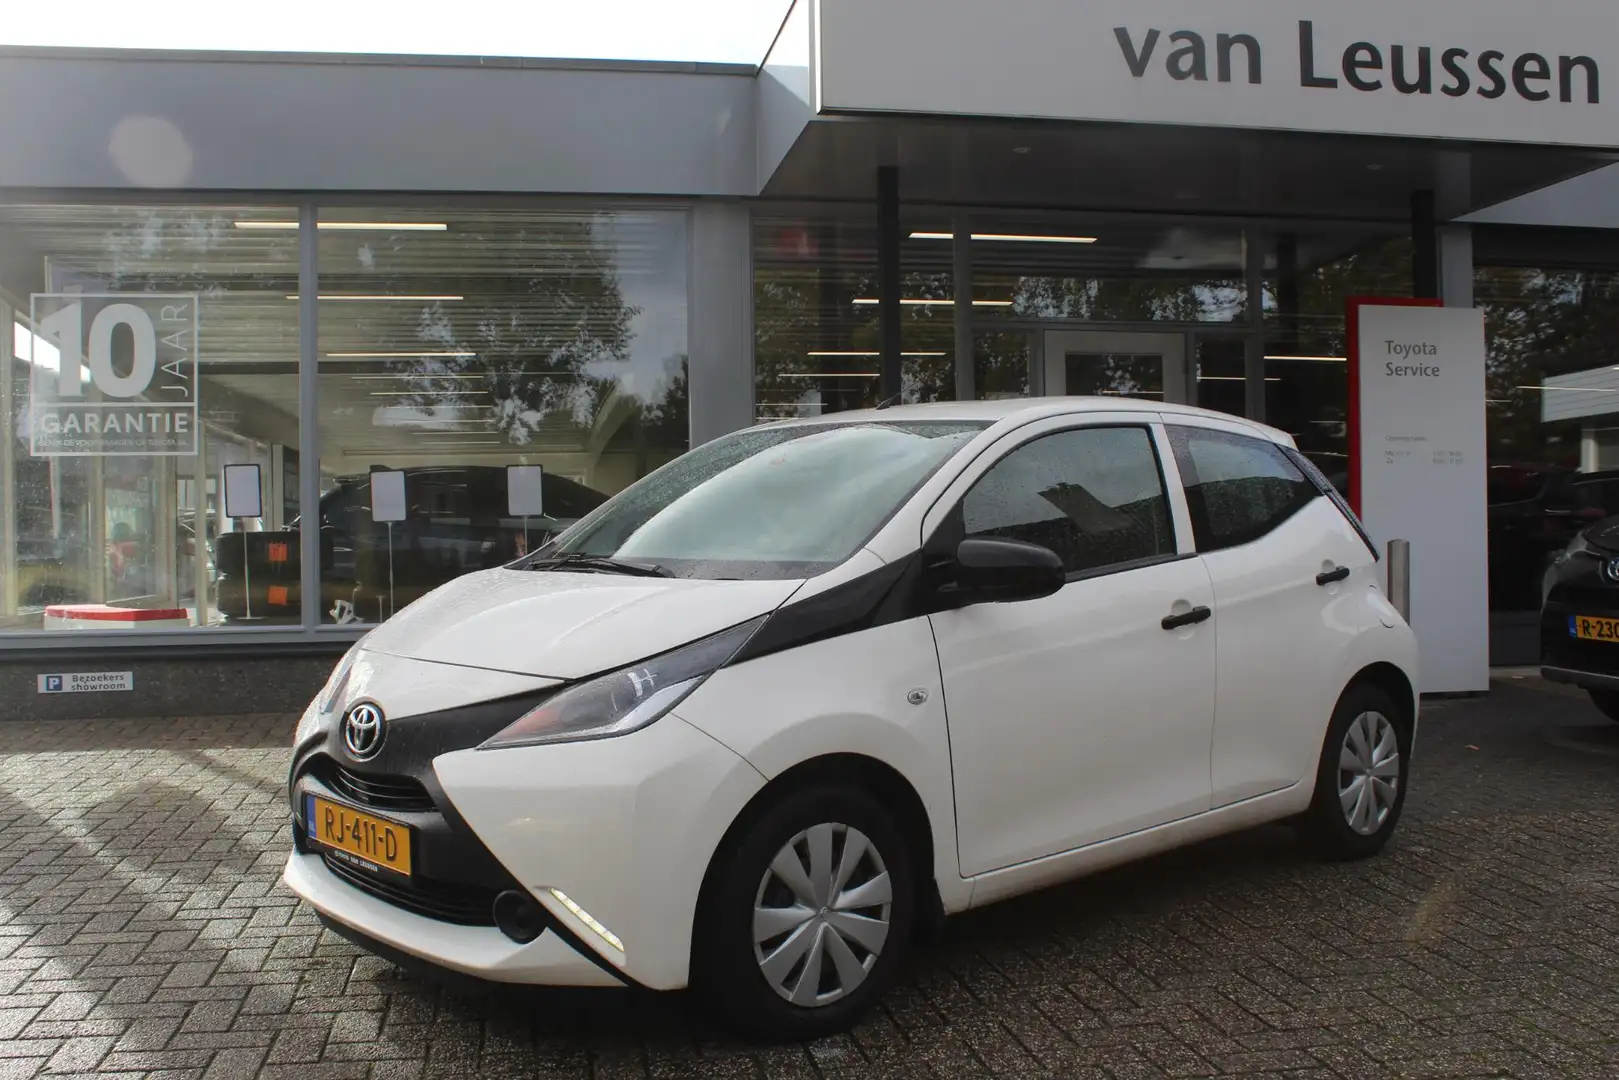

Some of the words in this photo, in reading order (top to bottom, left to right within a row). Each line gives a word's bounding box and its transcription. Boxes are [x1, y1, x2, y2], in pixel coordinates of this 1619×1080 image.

[1113, 26, 1262, 85] van
[1298, 19, 1600, 104] Leussen
[40, 302, 157, 398] 10
[160, 303, 189, 398] JAAR
[1384, 340, 1437, 360] Toyota
[1385, 361, 1440, 377] Service
[42, 412, 189, 434] GARANTIE
[71, 682, 126, 692] showroom
[72, 673, 125, 683] Bezoekers
[324, 805, 398, 862] RJ-411-D
